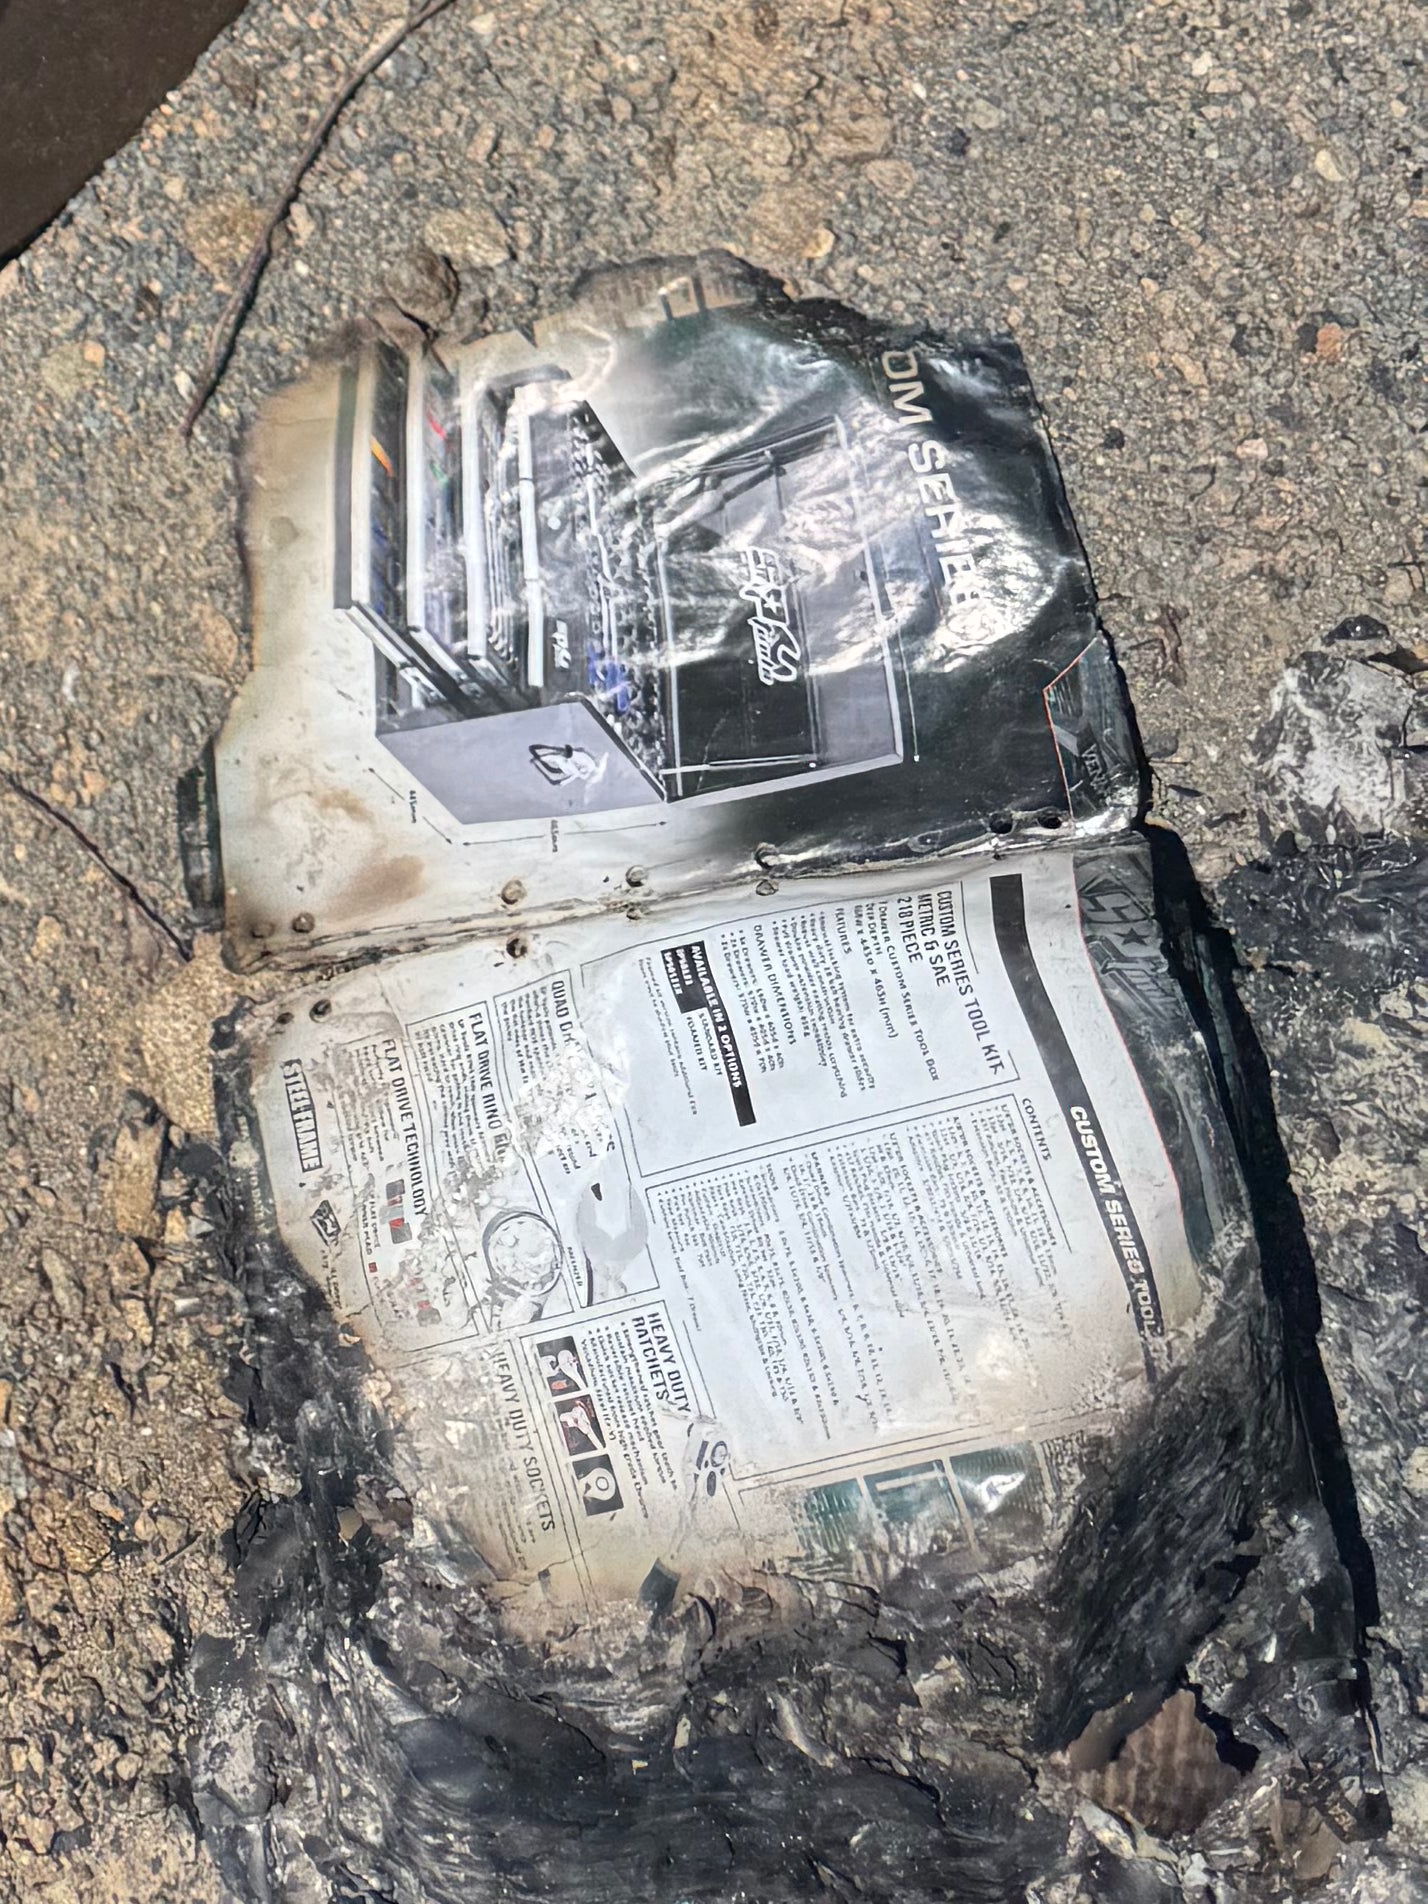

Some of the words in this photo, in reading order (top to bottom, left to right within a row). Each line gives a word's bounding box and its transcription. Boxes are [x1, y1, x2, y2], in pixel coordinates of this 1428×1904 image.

[896, 895, 913, 920] 218
[936, 889, 957, 938] CUSTOM
[898, 919, 923, 964] PIECE
[915, 892, 936, 938] METRIC
[928, 952, 951, 987] SAE
[942, 938, 974, 997] SERIES
[550, 979, 570, 1019] QUAD
[689, 943, 719, 1007] AVAILABLE
[719, 1033, 743, 1089] OPTIONS
[963, 998, 991, 1041] TOOL
[381, 1037, 402, 1074] FLAT
[467, 1011, 487, 1048] FLAT
[475, 1049, 494, 1090] DRIVE
[981, 1042, 1006, 1076] KIT
[390, 1076, 413, 1121] DRIVE
[292, 1111, 321, 1170] FRAME
[1020, 1096, 1053, 1162] CONTENTS
[401, 1121, 429, 1218] TECHNOLOGY
[1068, 1102, 1116, 1197] CUSTOM
[1103, 1196, 1145, 1277] SERIES
[631, 1315, 670, 1401] RATCHETS
[646, 1311, 676, 1367] HEAVY
[666, 1369, 691, 1415] DUTY
[489, 1351, 520, 1406] HEAVY
[508, 1407, 533, 1454] DUTY
[522, 1454, 556, 1533] SOCKETS
